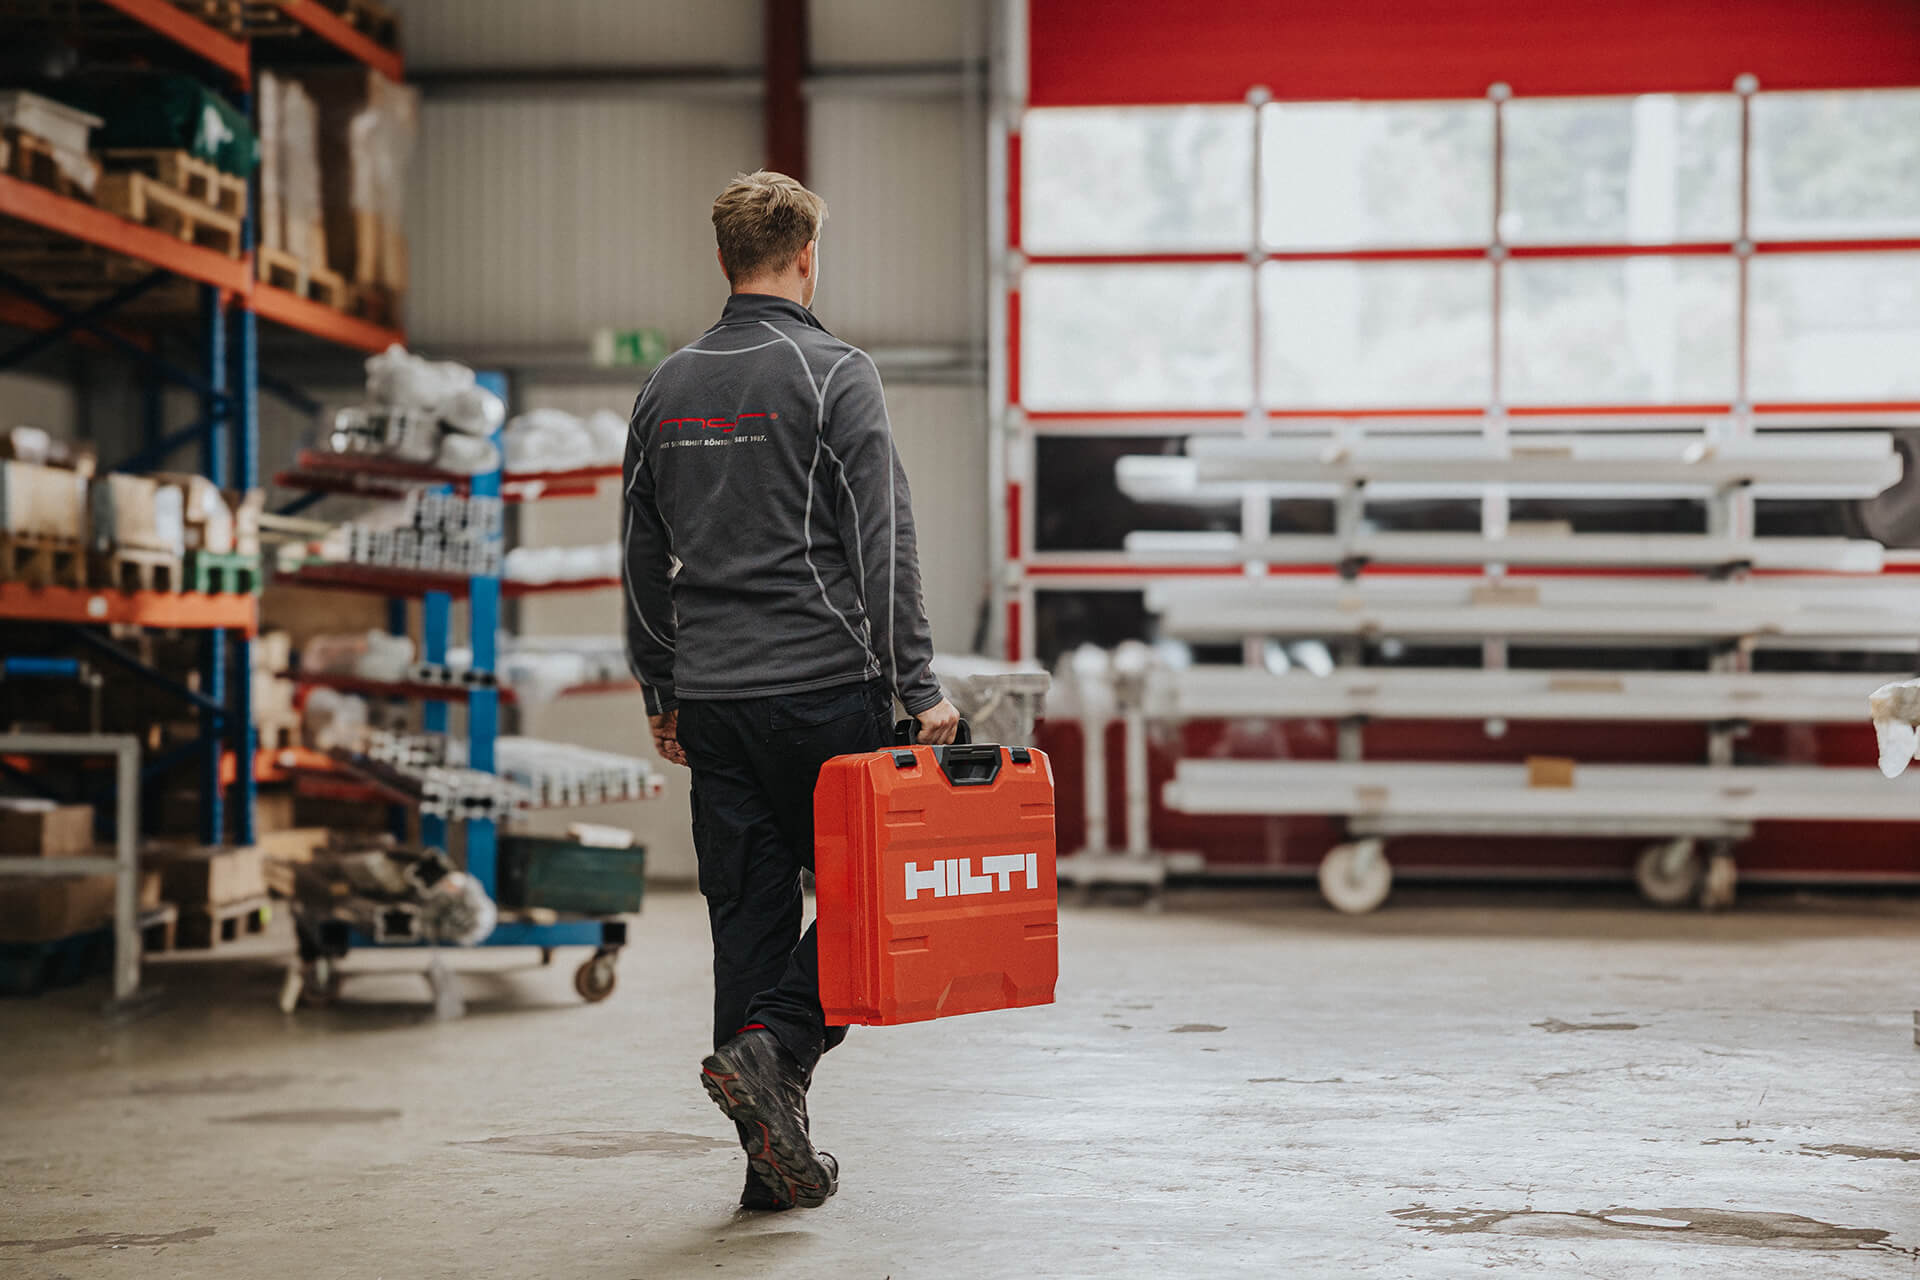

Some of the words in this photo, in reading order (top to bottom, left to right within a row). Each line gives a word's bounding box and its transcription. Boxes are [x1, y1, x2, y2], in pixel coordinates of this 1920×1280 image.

[704, 438, 733, 447] RÖNIS
[734, 435, 749, 443] SEIT
[905, 853, 1038, 900] HILTI
